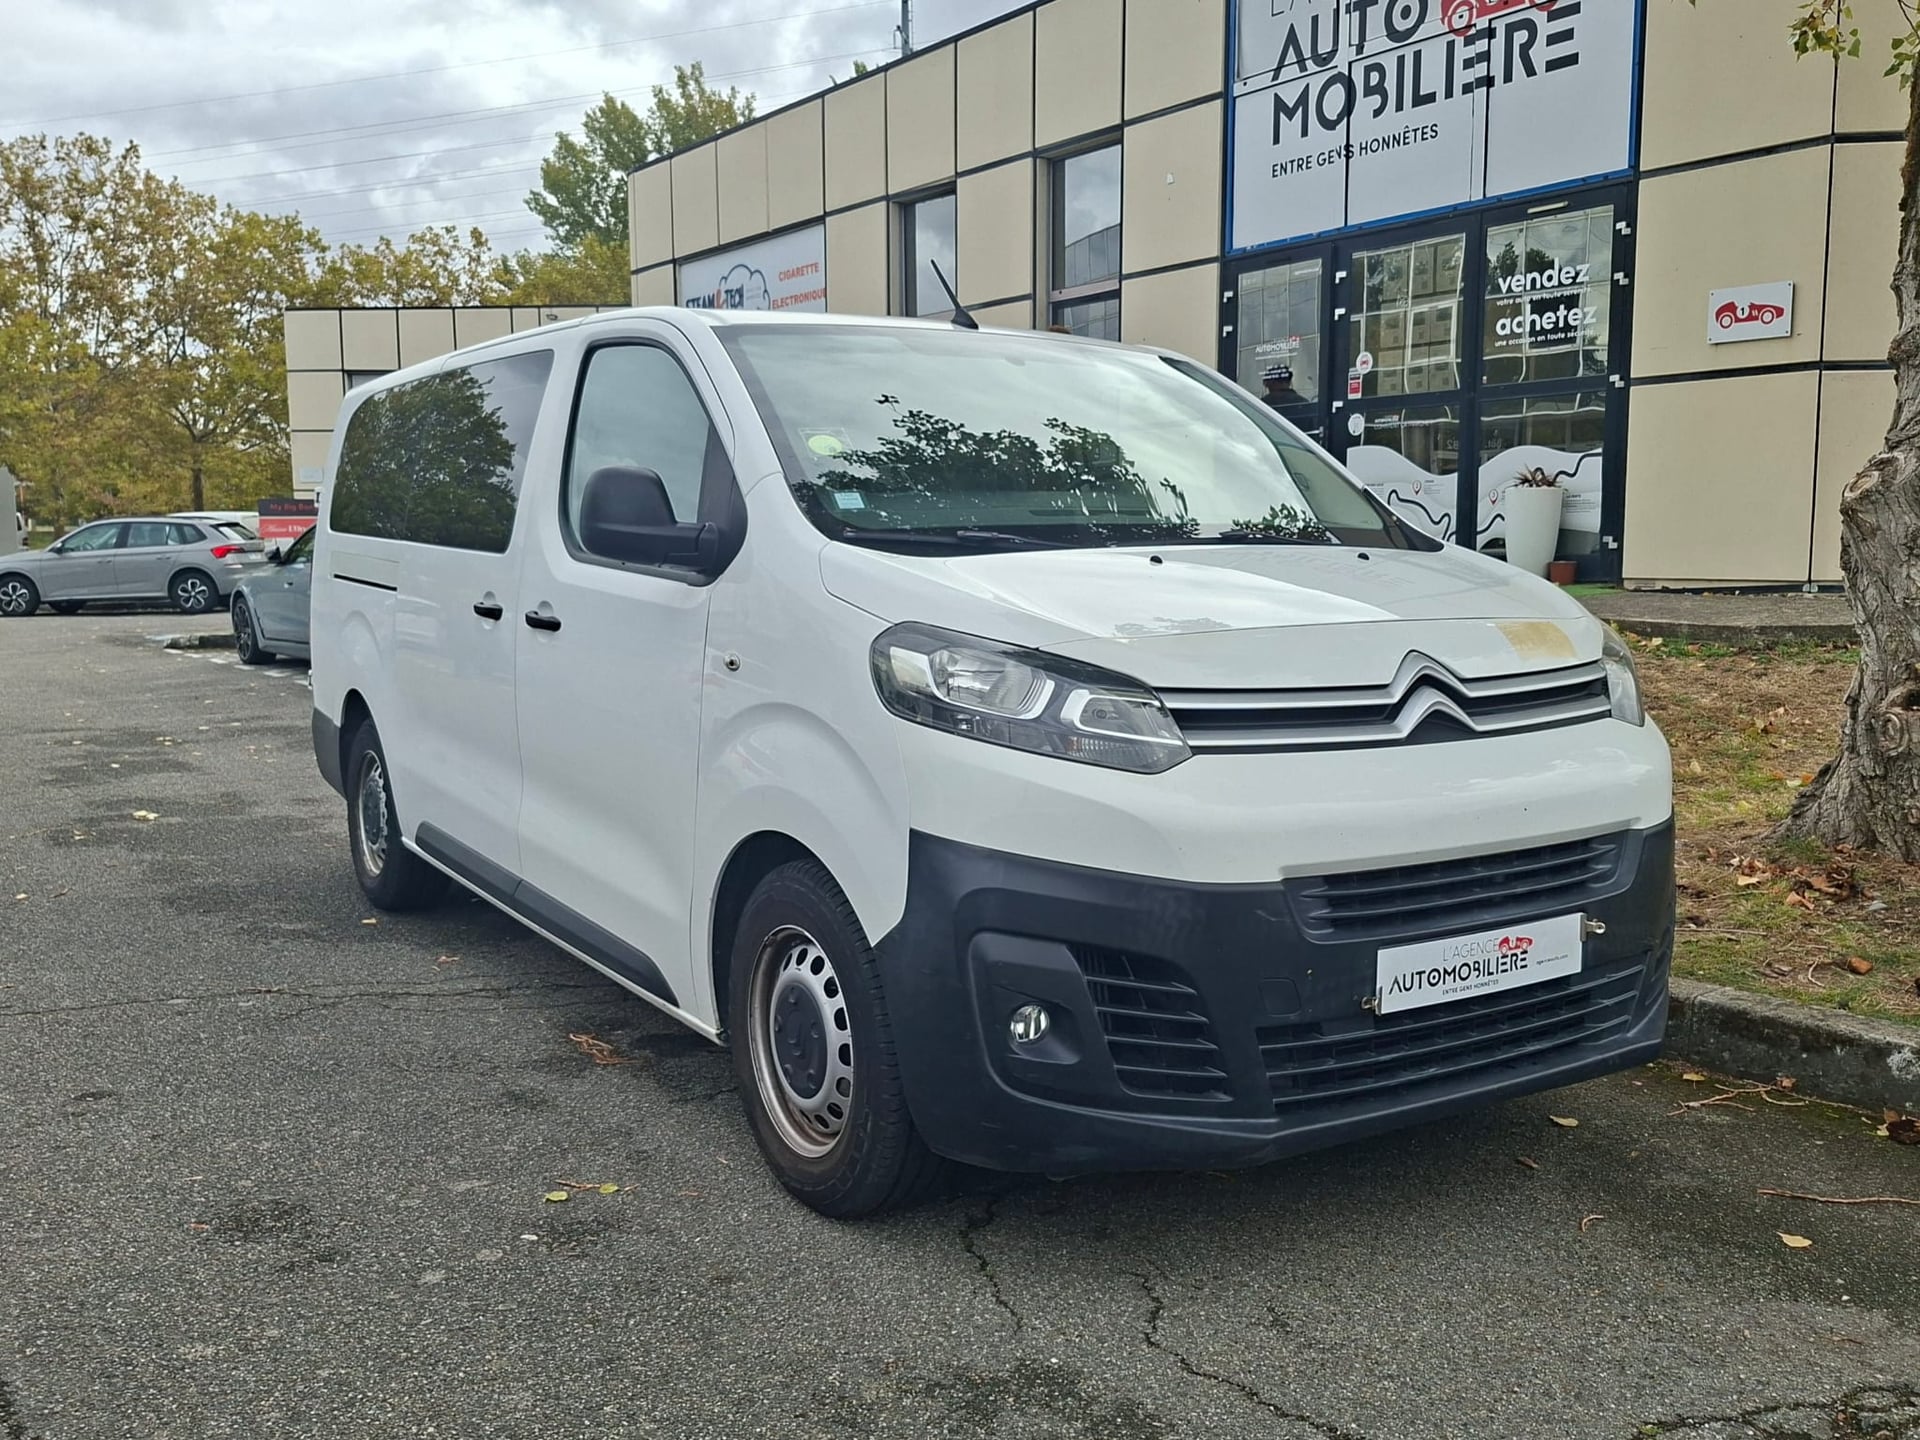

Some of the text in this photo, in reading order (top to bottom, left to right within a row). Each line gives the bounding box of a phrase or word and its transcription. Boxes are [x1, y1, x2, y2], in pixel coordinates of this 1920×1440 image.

[1270, 0, 1429, 82] AUTO
[1271, 155, 1313, 178] ENTRE
[1359, 123, 1439, 157] HONNÊTES
[779, 262, 819, 282] CIGARETTE
[1498, 257, 1590, 294] vendez
[1495, 304, 1597, 336] achetez
[1443, 938, 1500, 962] L'AGENCE
